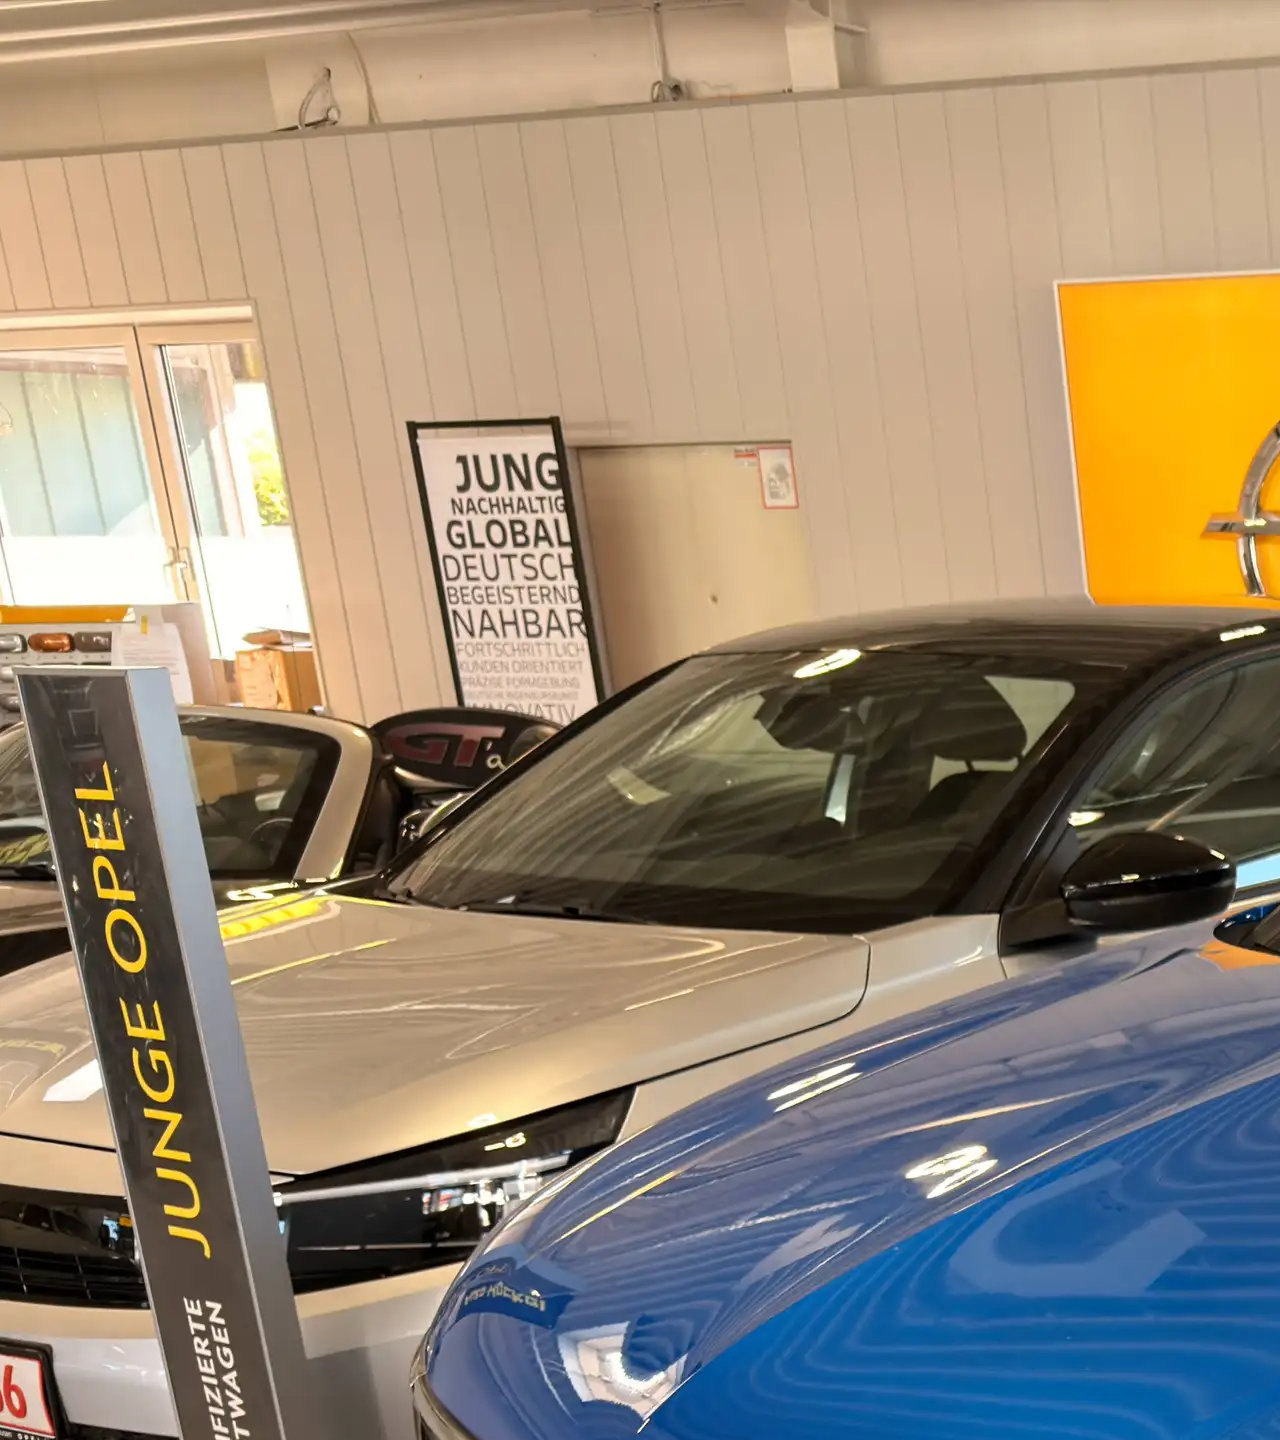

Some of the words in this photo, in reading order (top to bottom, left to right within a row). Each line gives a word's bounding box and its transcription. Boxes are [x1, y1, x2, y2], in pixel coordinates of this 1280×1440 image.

[455, 452, 563, 493] JUNG
[450, 495, 567, 516] NACHHALTIG
[446, 518, 573, 550] GLOBAL
[442, 553, 576, 581] DEUTSCH
[446, 584, 580, 606] BEGEISTERND
[452, 608, 588, 639] NAHBAR
[455, 642, 585, 658] FORTSCHRITTLICH
[460, 660, 508, 674] KUNDEN
[511, 660, 584, 674] ORIENTIERT
[386, 723, 506, 767] GT
[74, 760, 148, 974] OPEL
[118, 996, 211, 1260] JUNGE
